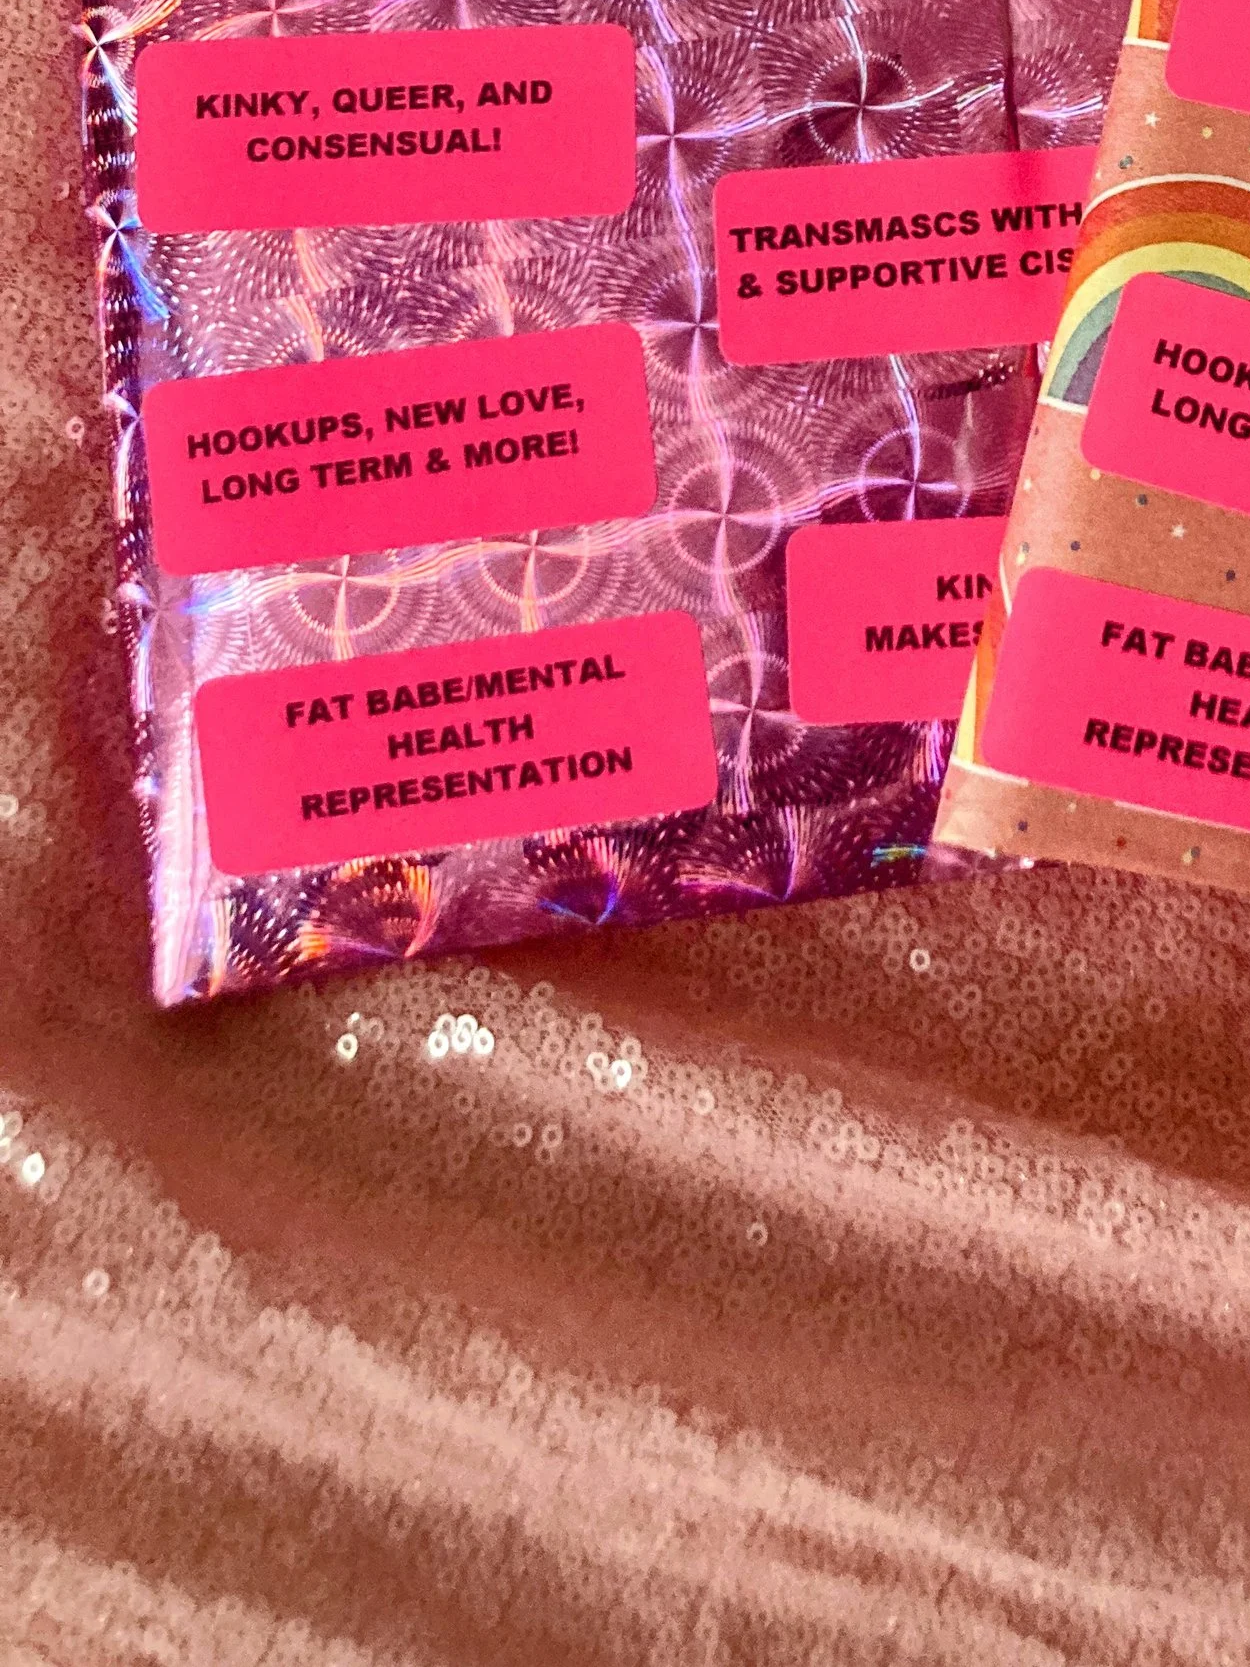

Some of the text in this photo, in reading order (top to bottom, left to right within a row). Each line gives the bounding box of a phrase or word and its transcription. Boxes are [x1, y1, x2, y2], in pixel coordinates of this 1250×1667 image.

[196, 80, 553, 119] KINKY, QUEER, AND
[246, 127, 501, 163] CONSENSUAL!
[729, 202, 1083, 253] TRANSMASCS WITH
[737, 247, 1074, 299] & SUPPORTIVE CIS
[187, 384, 584, 459] HOOKUPS, NEW LOVE,
[202, 429, 578, 504] LONG TERM & MORE!
[936, 575, 992, 601] KIN
[1101, 621, 1175, 659] FAT
[286, 655, 625, 728] FAT BABE/MENTAL
[388, 714, 534, 759] HEALTH
[301, 747, 632, 820] REPRESENTATION
